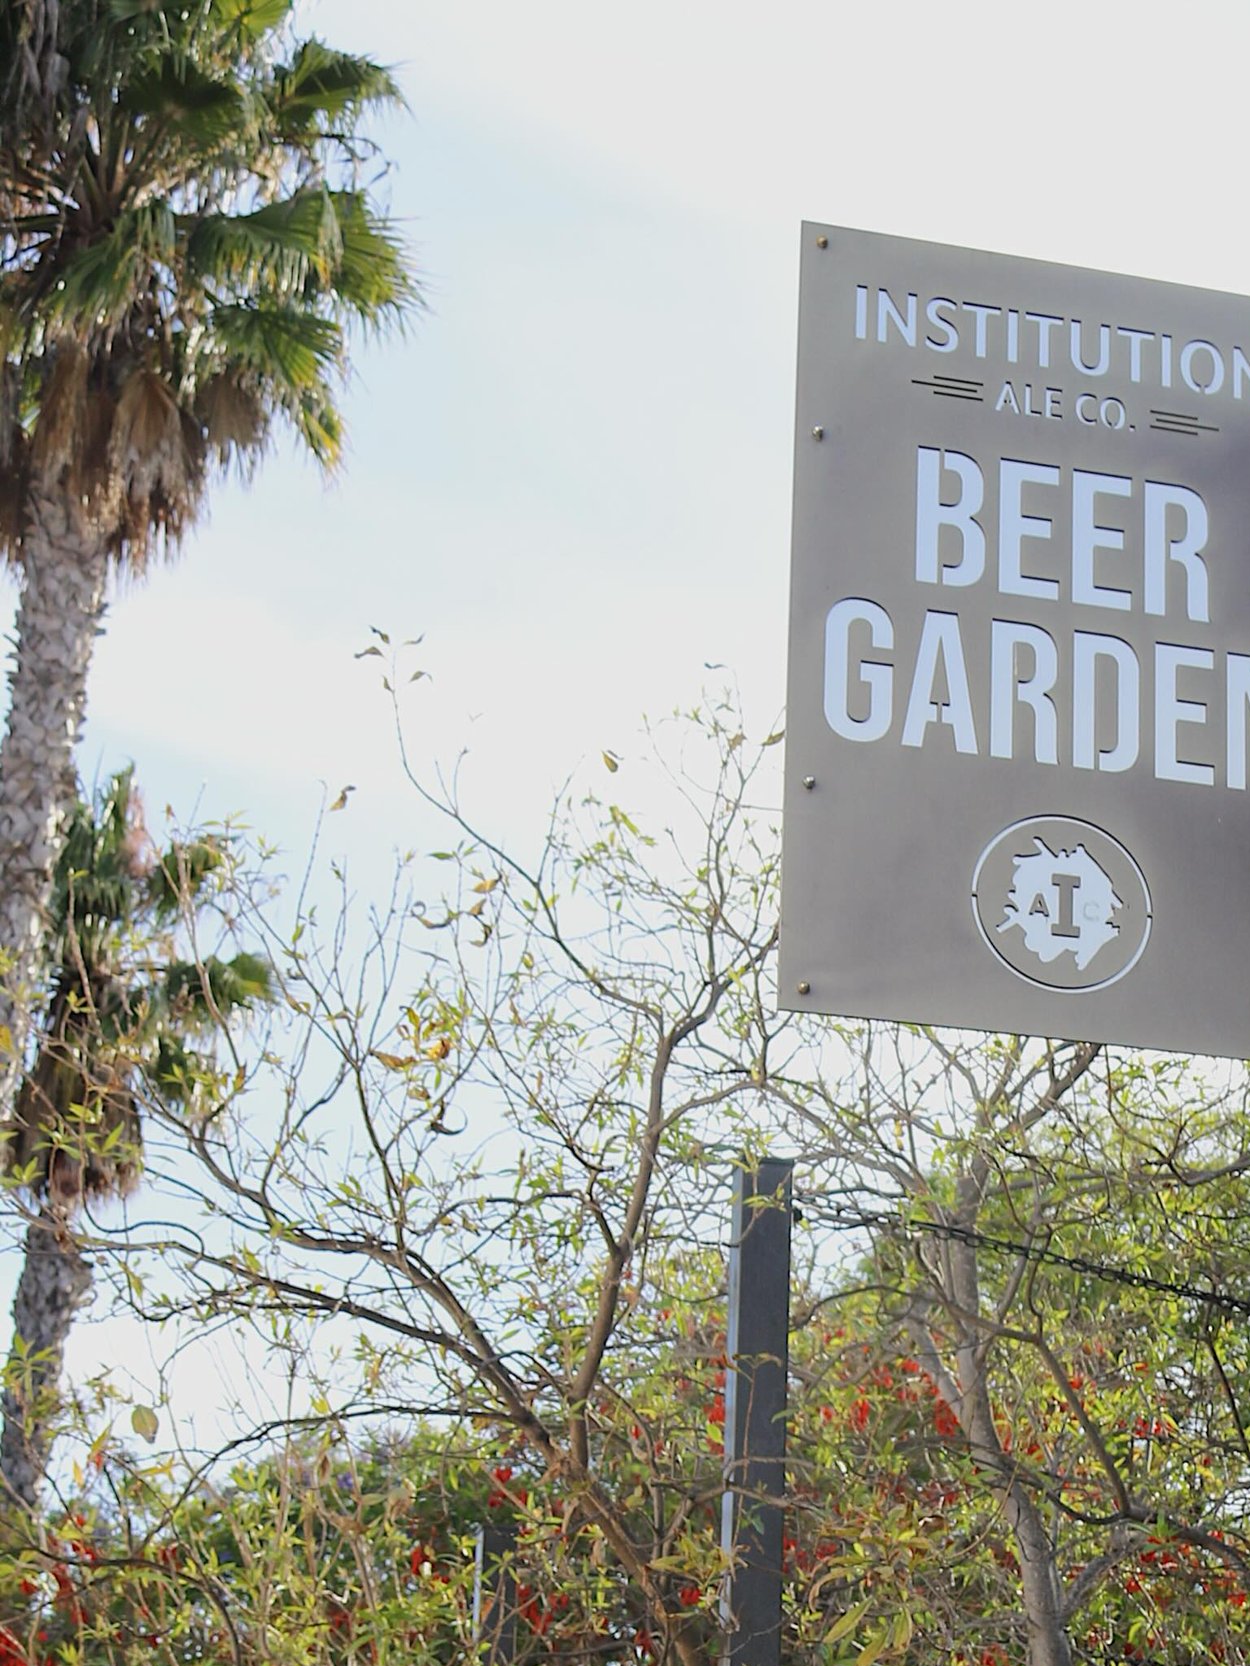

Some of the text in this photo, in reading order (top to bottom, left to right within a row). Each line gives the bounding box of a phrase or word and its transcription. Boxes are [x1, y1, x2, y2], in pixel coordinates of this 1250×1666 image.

[995, 381, 1136, 432] ALE CO.
[915, 445, 1210, 623] BEER
